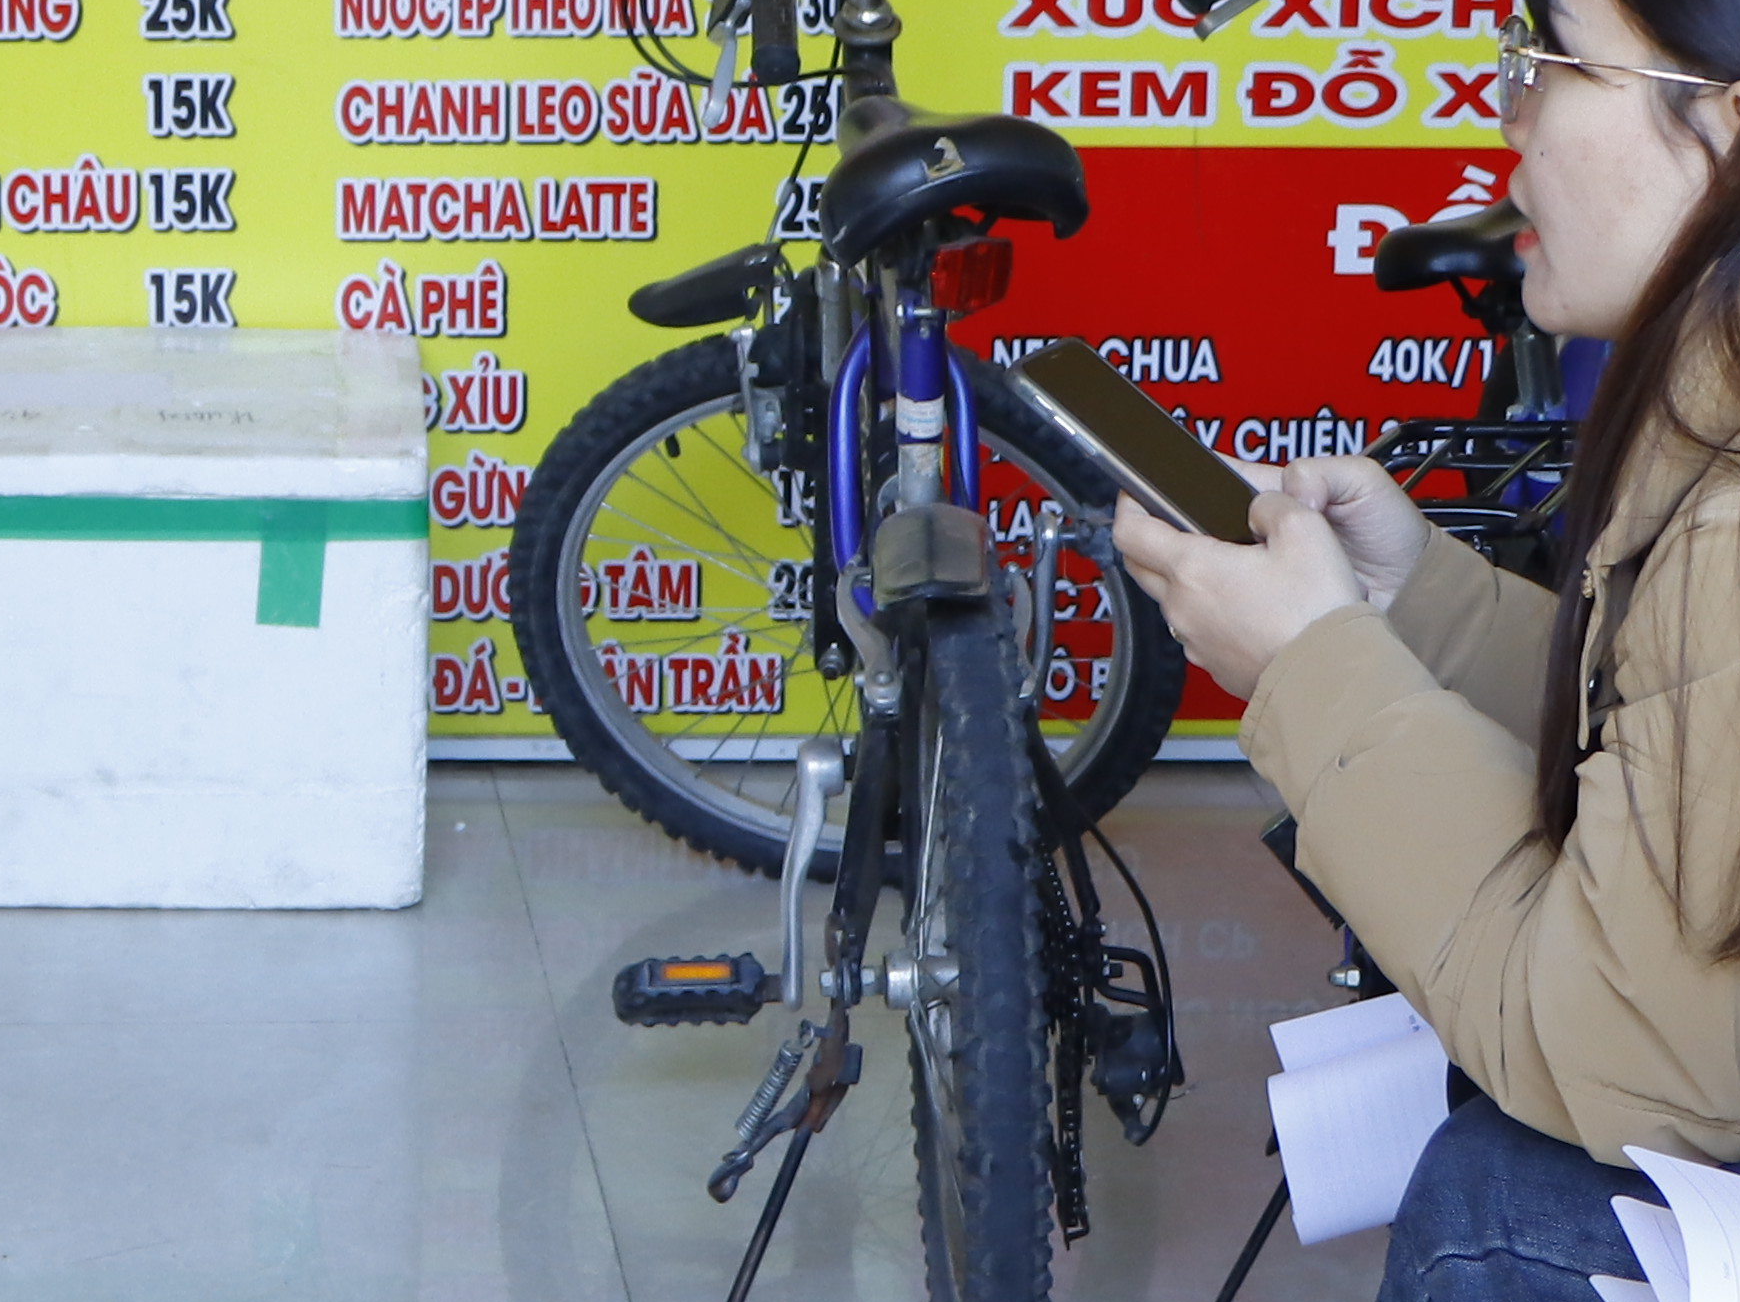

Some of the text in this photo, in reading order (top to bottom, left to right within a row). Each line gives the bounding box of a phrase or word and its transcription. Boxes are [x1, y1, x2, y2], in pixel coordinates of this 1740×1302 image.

[146, 77, 231, 134] 15K
[340, 83, 502, 139] CHANH
[516, 82, 595, 138] LEO
[605, 70, 693, 138] SỮA
[1010, 68, 1211, 120] KEM
[1245, 47, 1400, 121] ĐỖ
[5, 157, 133, 227] CHÂU
[146, 171, 231, 227] 15K
[341, 181, 527, 236] MATCHA
[539, 180, 650, 235] LATTE
[146, 273, 232, 327] 15K
[340, 264, 500, 333] CÀ PHÊ
[446, 355, 520, 427] XỈU
[1104, 338, 1220, 383] CHUA
[604, 550, 694, 613] TÂM
[432, 642, 495, 708] ĐÁ
